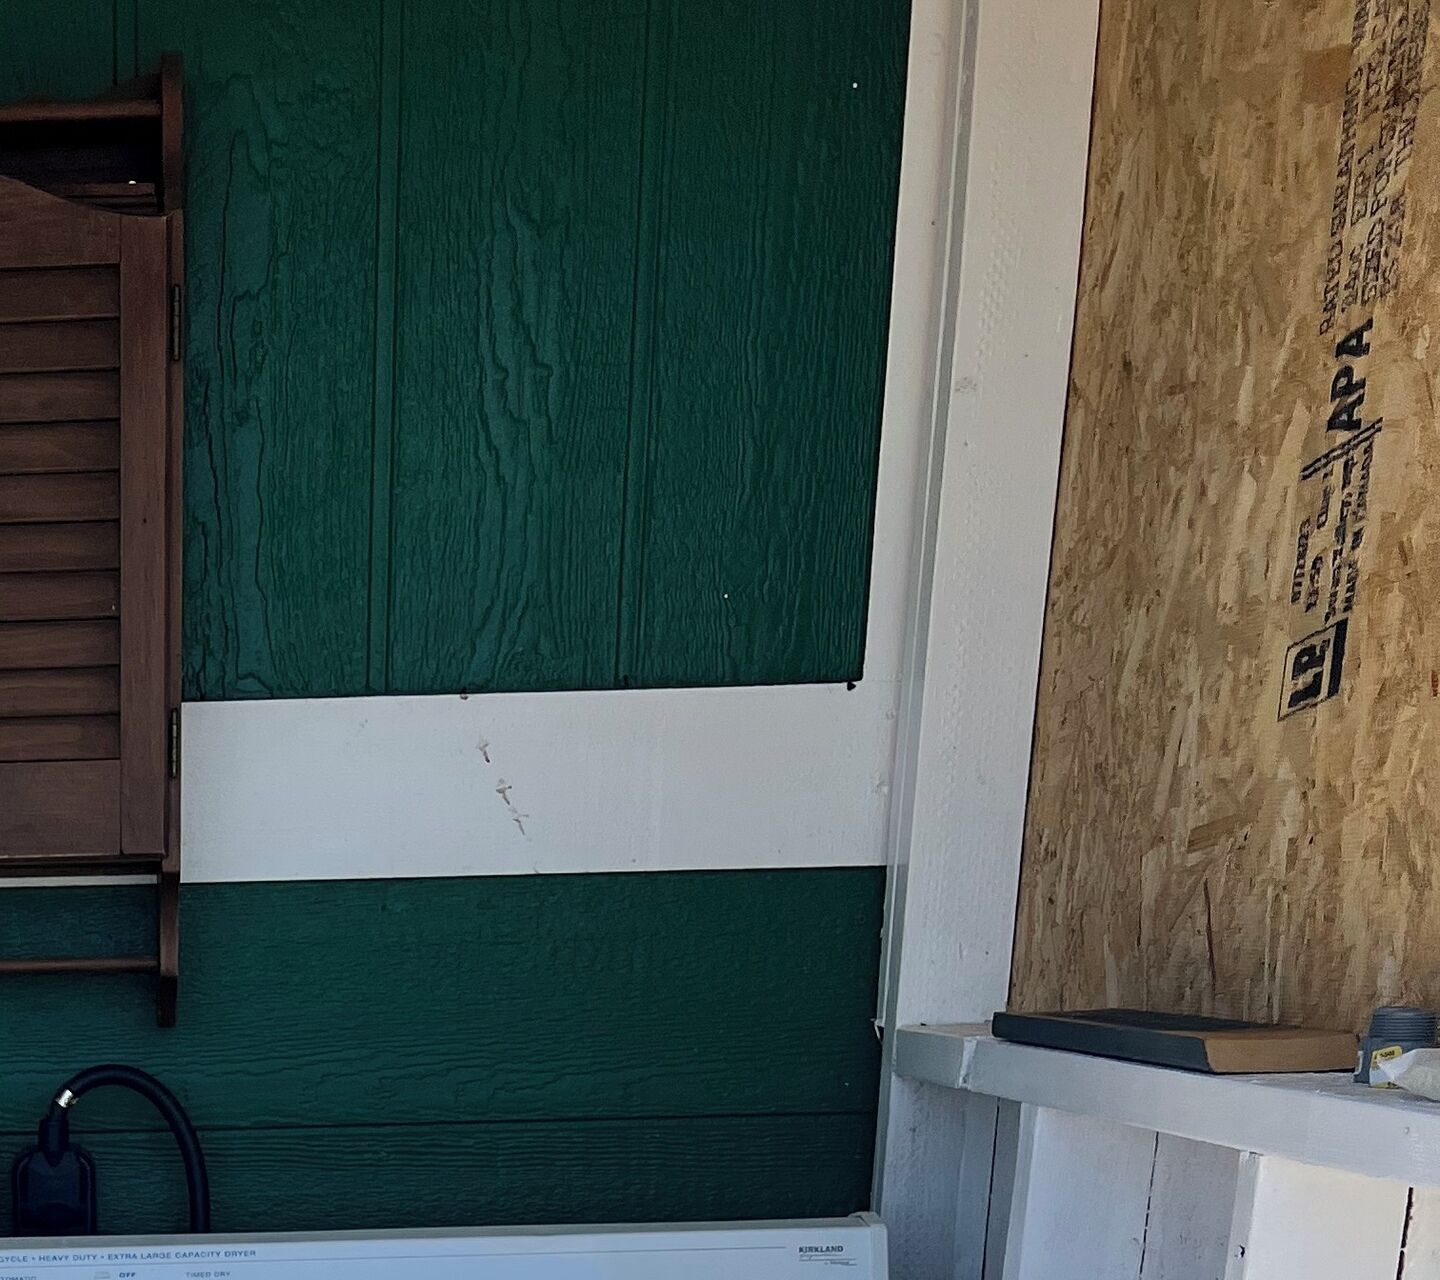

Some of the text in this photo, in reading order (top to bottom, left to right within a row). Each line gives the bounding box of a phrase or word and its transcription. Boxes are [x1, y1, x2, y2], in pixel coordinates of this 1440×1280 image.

[1325, 317, 1374, 435] APA
[1287, 636, 1332, 711] LP
[798, 1245, 844, 1254] KIRKLAND
[38, 1254, 69, 1262] HEAVY
[108, 1253, 137, 1261] EXTRA
[140, 1252, 172, 1260] LARGE
[175, 1250, 221, 1259] CAPACITY
[186, 1271, 211, 1279] TIMED
